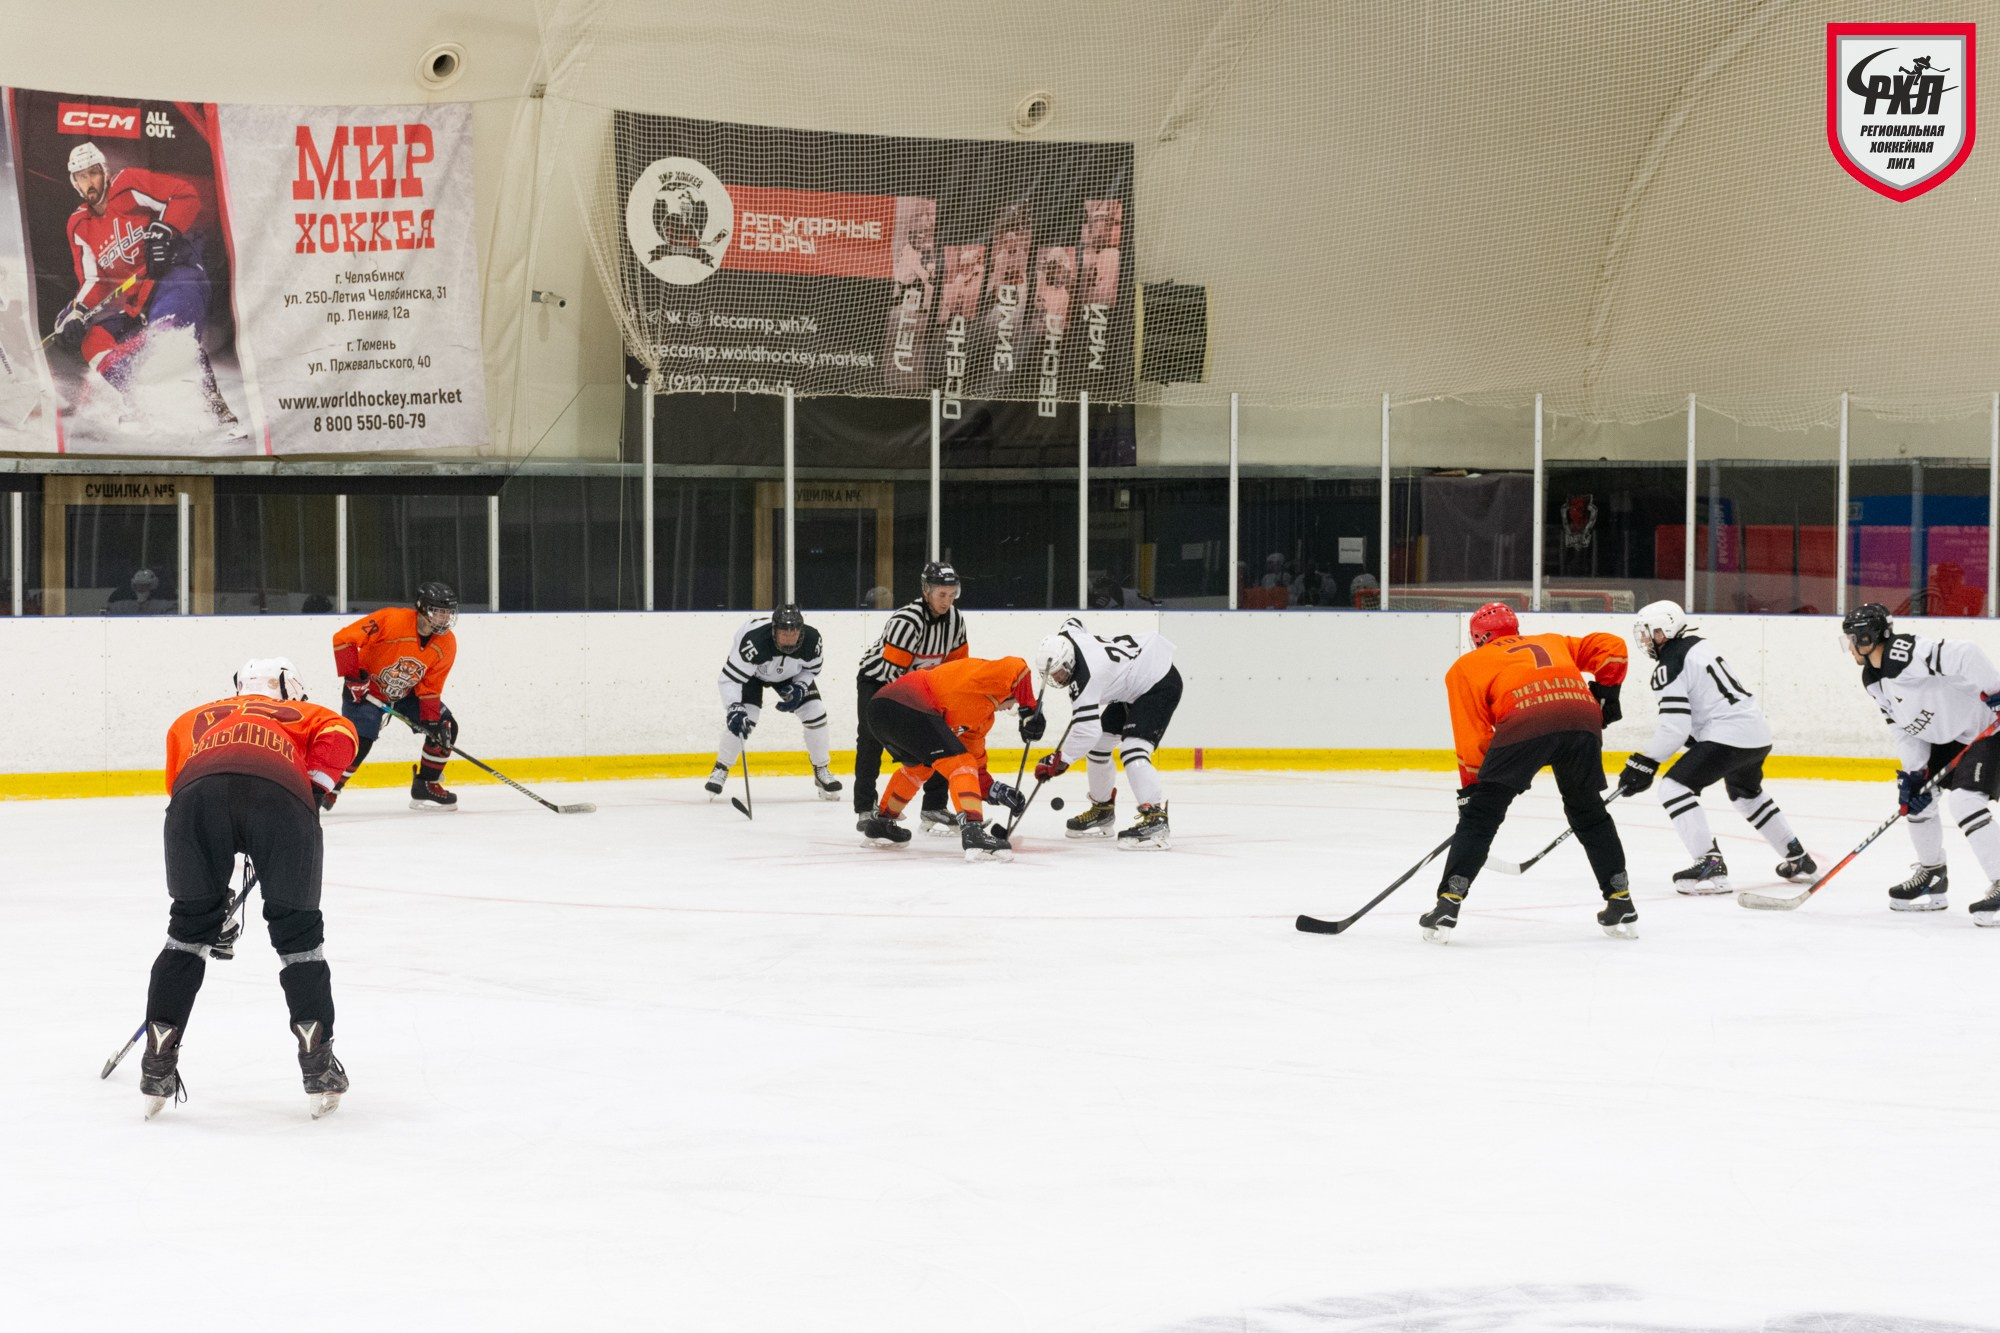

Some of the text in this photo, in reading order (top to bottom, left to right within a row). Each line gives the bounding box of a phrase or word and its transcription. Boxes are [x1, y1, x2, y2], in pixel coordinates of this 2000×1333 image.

[62, 111, 136, 131] CCM
[146, 111, 170, 125] ALL
[145, 124, 176, 139] OUT.
[292, 123, 435, 201] МИР
[294, 209, 436, 254] ХОККЕЯ
[741, 211, 882, 240] РЕГУЛЯРНЫЕ
[740, 232, 816, 254] СБОРЫ
[335, 269, 405, 285] г. Челябинск
[284, 286, 447, 308] ул. 250-Летия Челябинска, 31
[326, 306, 410, 325] пр. Ленина, 12а
[709, 310, 818, 335] icecamp_wh74
[993, 284, 1019, 372] ЗИМА
[1083, 303, 1108, 370] МАЙ
[346, 338, 396, 352] г. Тюмень
[646, 343, 875, 369] cecamp.worldhockey.market
[308, 355, 431, 376] ул. Пржевальского, 40
[942, 315, 966, 420] ОСЕНЬ
[1037, 314, 1064, 418] ВЕСНА
[278, 387, 463, 410] www.worldhockey.market
[313, 413, 427, 432] 8 800 550-60-79
[85, 483, 175, 498] СУШИЛКА №5
[794, 488, 842, 502] УШИЛКА
[741, 639, 759, 662] 75
[1506, 643, 1554, 670] 7
[1889, 638, 1913, 663] 88
[1512, 677, 1588, 700] МЕТАЛЛУР
[1650, 665, 1668, 691] 10
[1903, 708, 1935, 737] ЕНДА
